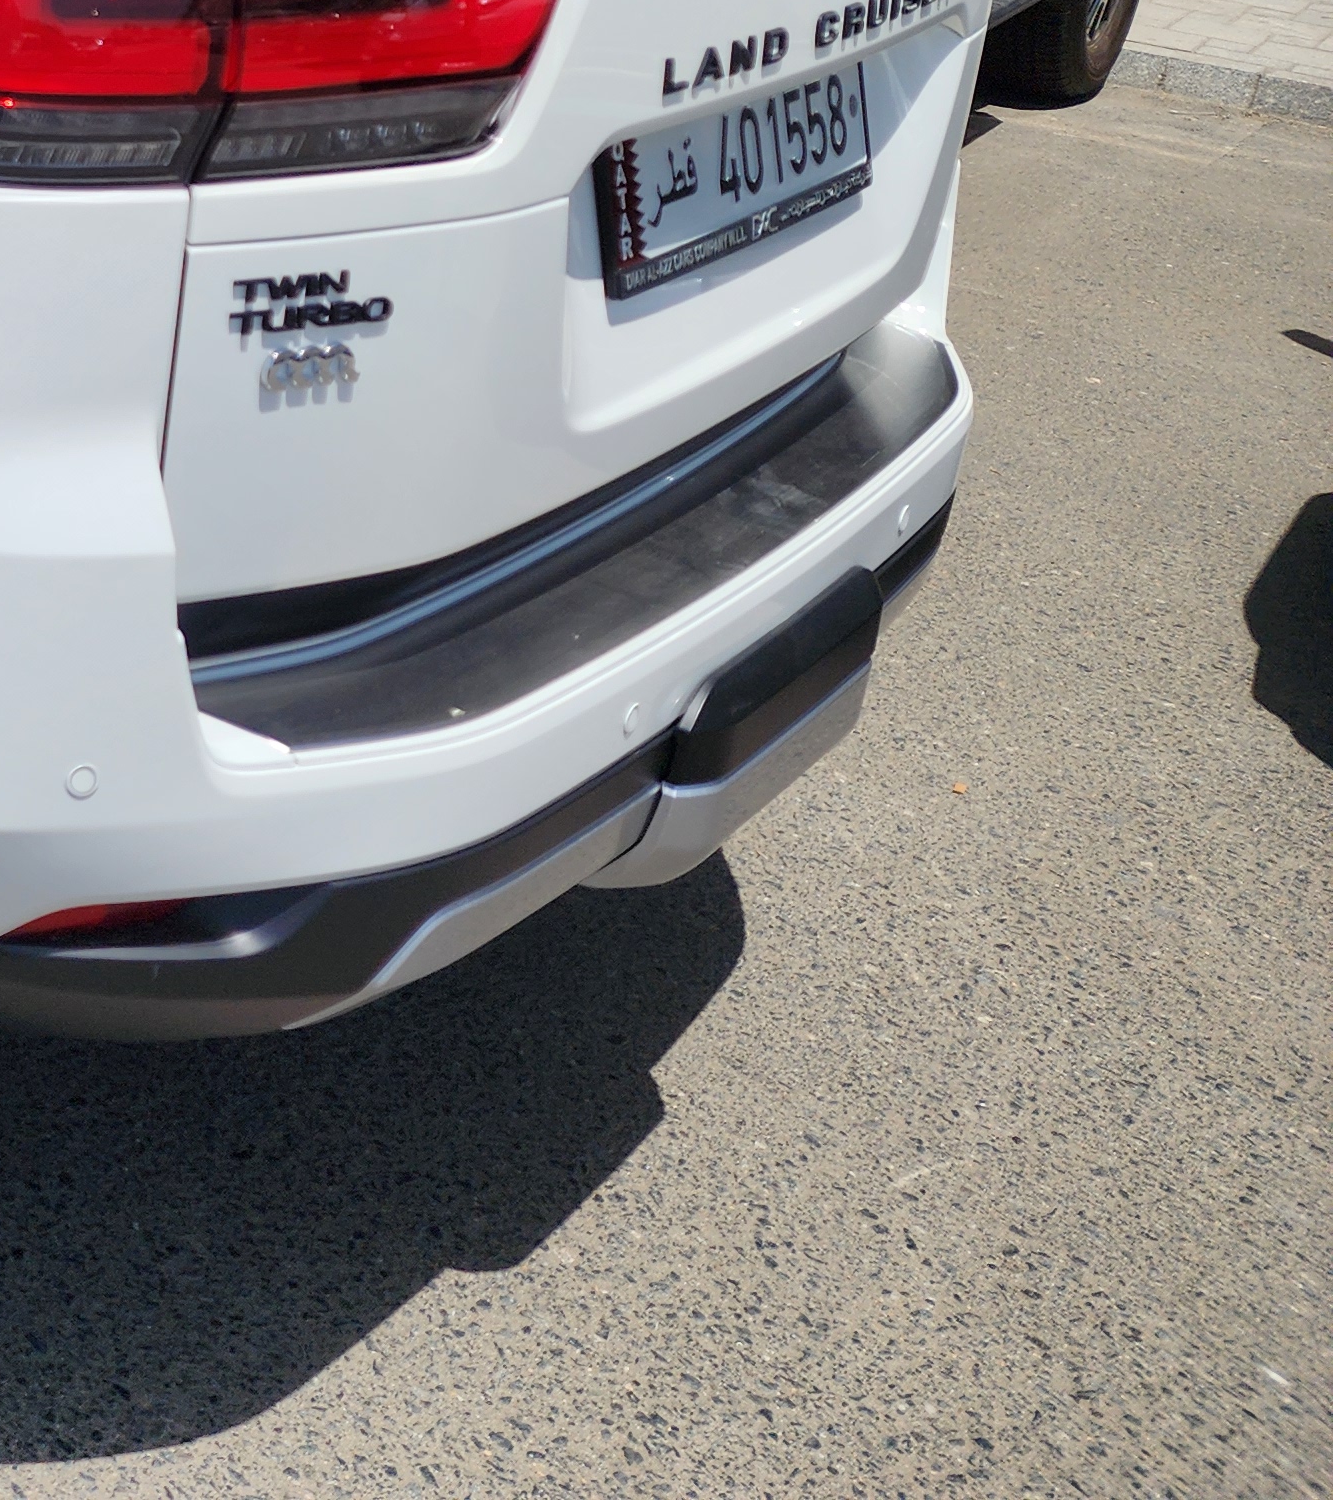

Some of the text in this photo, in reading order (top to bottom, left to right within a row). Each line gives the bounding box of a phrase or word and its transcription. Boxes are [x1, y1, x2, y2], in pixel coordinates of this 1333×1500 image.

[662, 26, 790, 97] LAND
[720, 74, 848, 204] 401558
[647, 134, 699, 227] قطر
[229, 296, 394, 335] TURBO
[233, 268, 350, 303] TWIN
